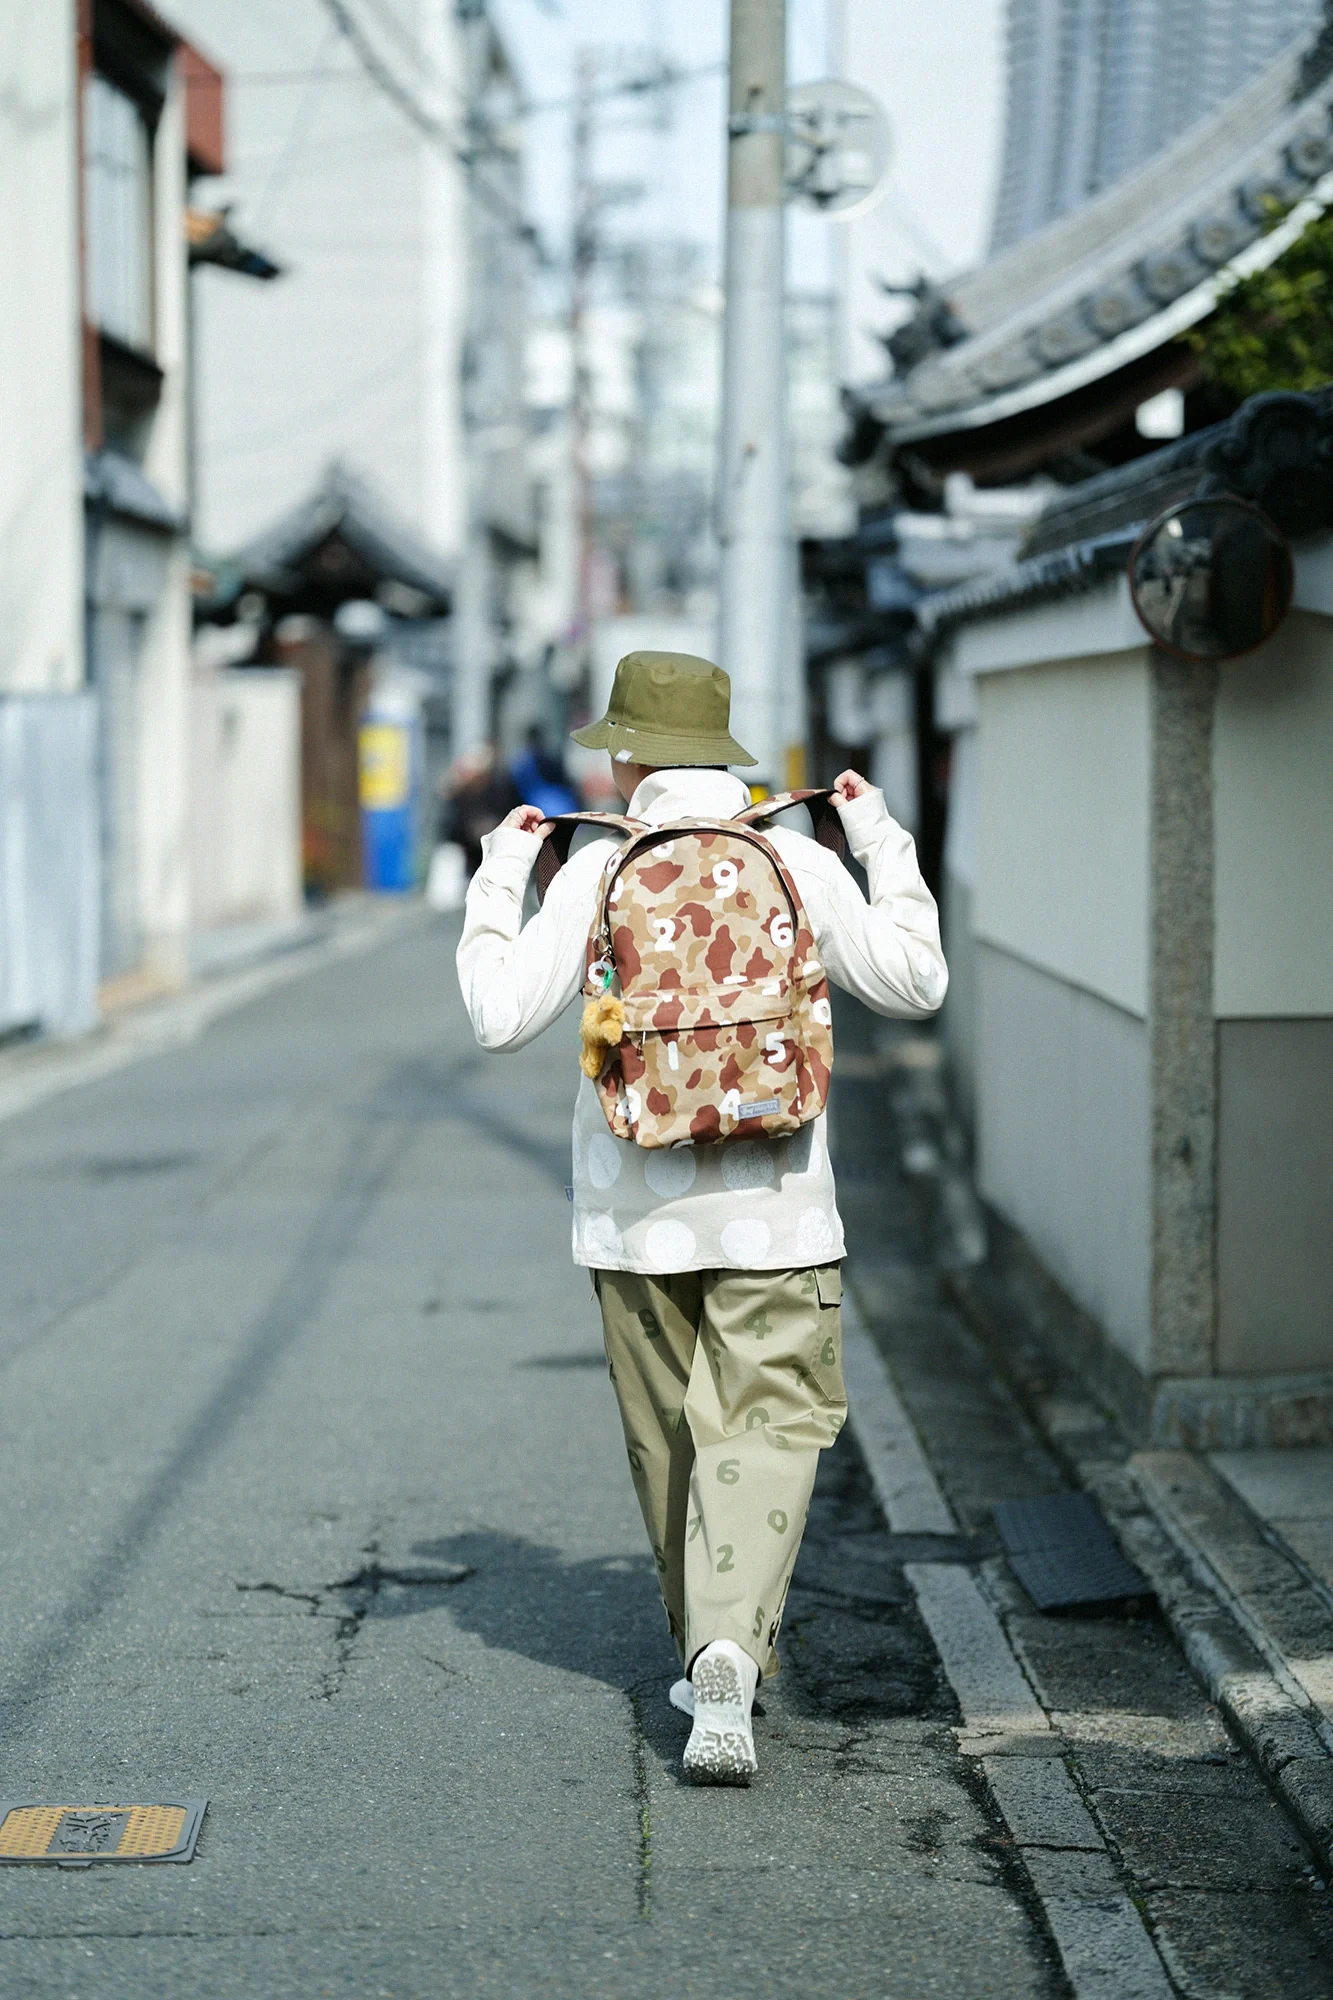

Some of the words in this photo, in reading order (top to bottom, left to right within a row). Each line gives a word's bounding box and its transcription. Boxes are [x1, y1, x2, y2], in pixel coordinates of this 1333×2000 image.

[713, 861, 738, 898] 9
[653, 918, 676, 951] 2
[770, 914, 793, 948] 6
[766, 1032, 786, 1063] 5
[719, 1089, 740, 1121] 4
[744, 1309, 773, 1340] 4
[821, 1337, 835, 1366] 6
[716, 1459, 740, 1485] 6
[688, 1515, 701, 1542] 7
[767, 1509, 788, 1534] 0
[717, 1544, 735, 1573] 2
